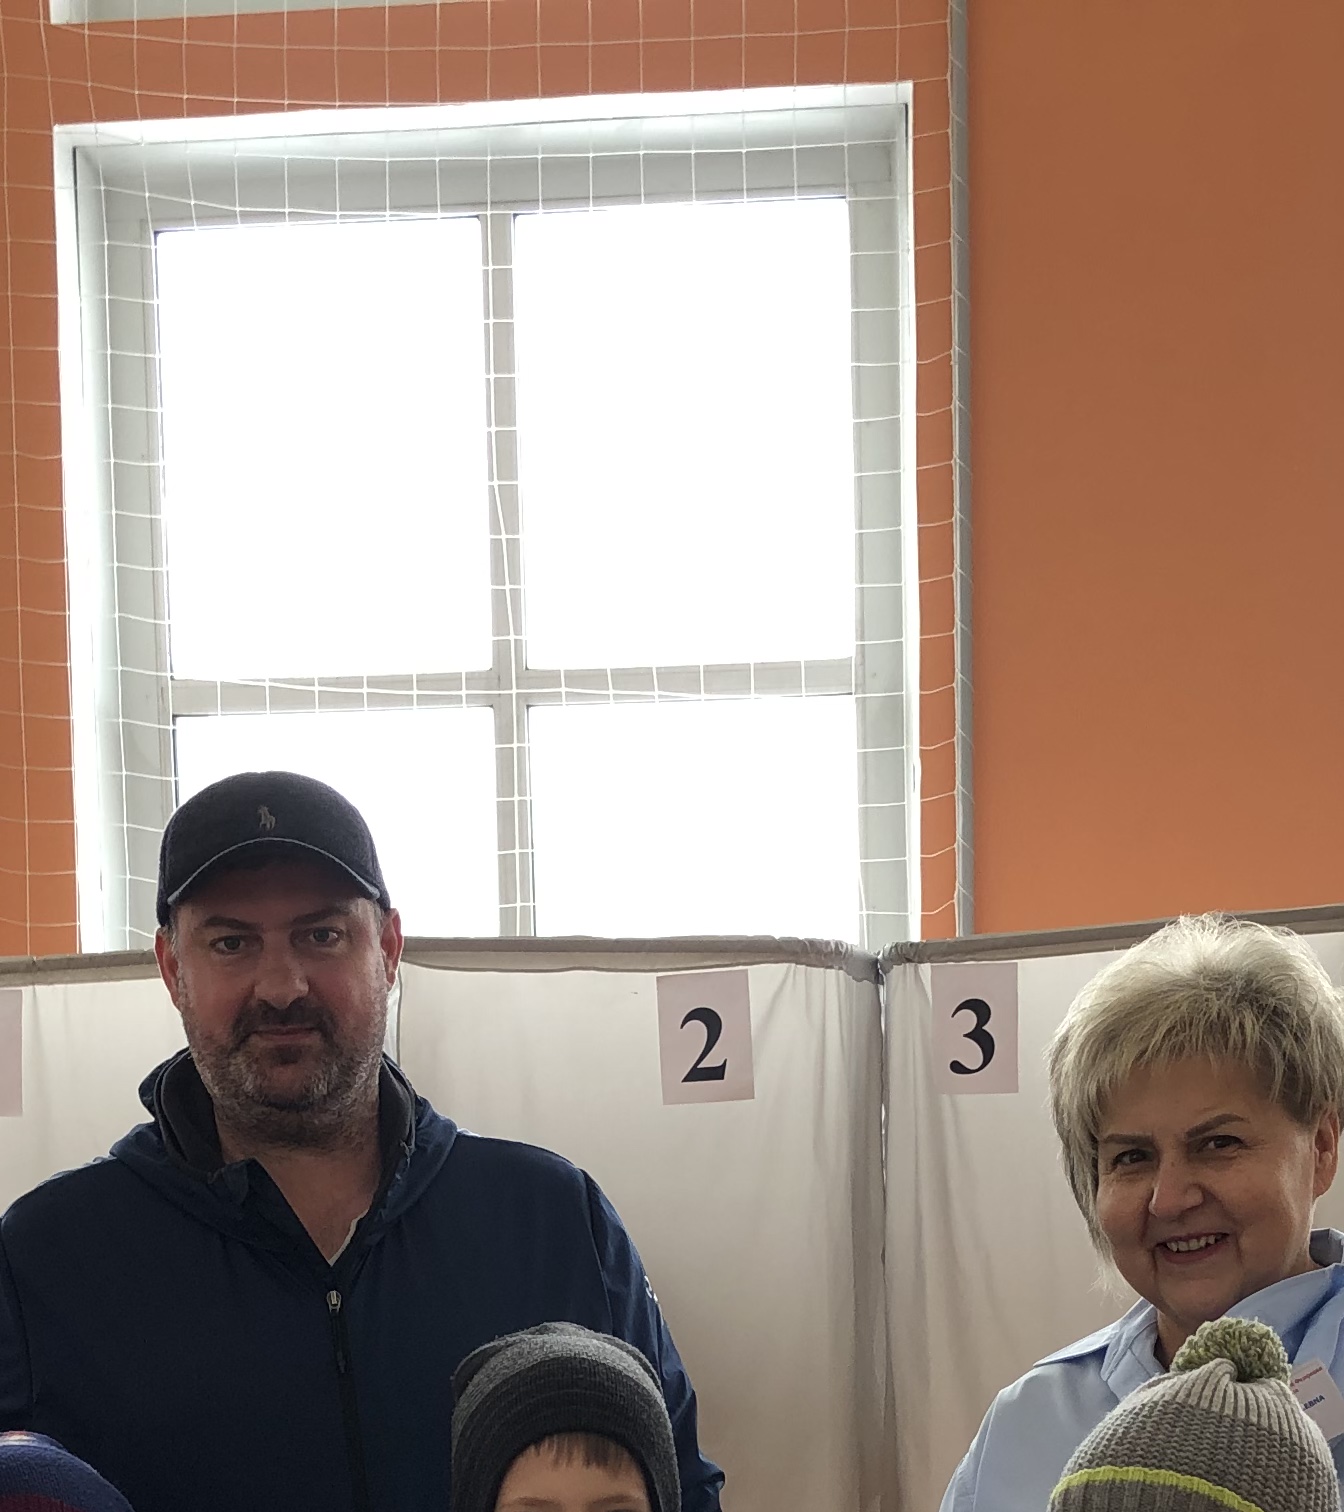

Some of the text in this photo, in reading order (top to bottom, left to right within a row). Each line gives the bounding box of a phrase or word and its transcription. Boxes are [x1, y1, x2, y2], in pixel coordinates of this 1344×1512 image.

[680, 1007, 728, 1083] 2
[949, 998, 996, 1075] 3
[1302, 1394, 1326, 1411] ЕВНА
